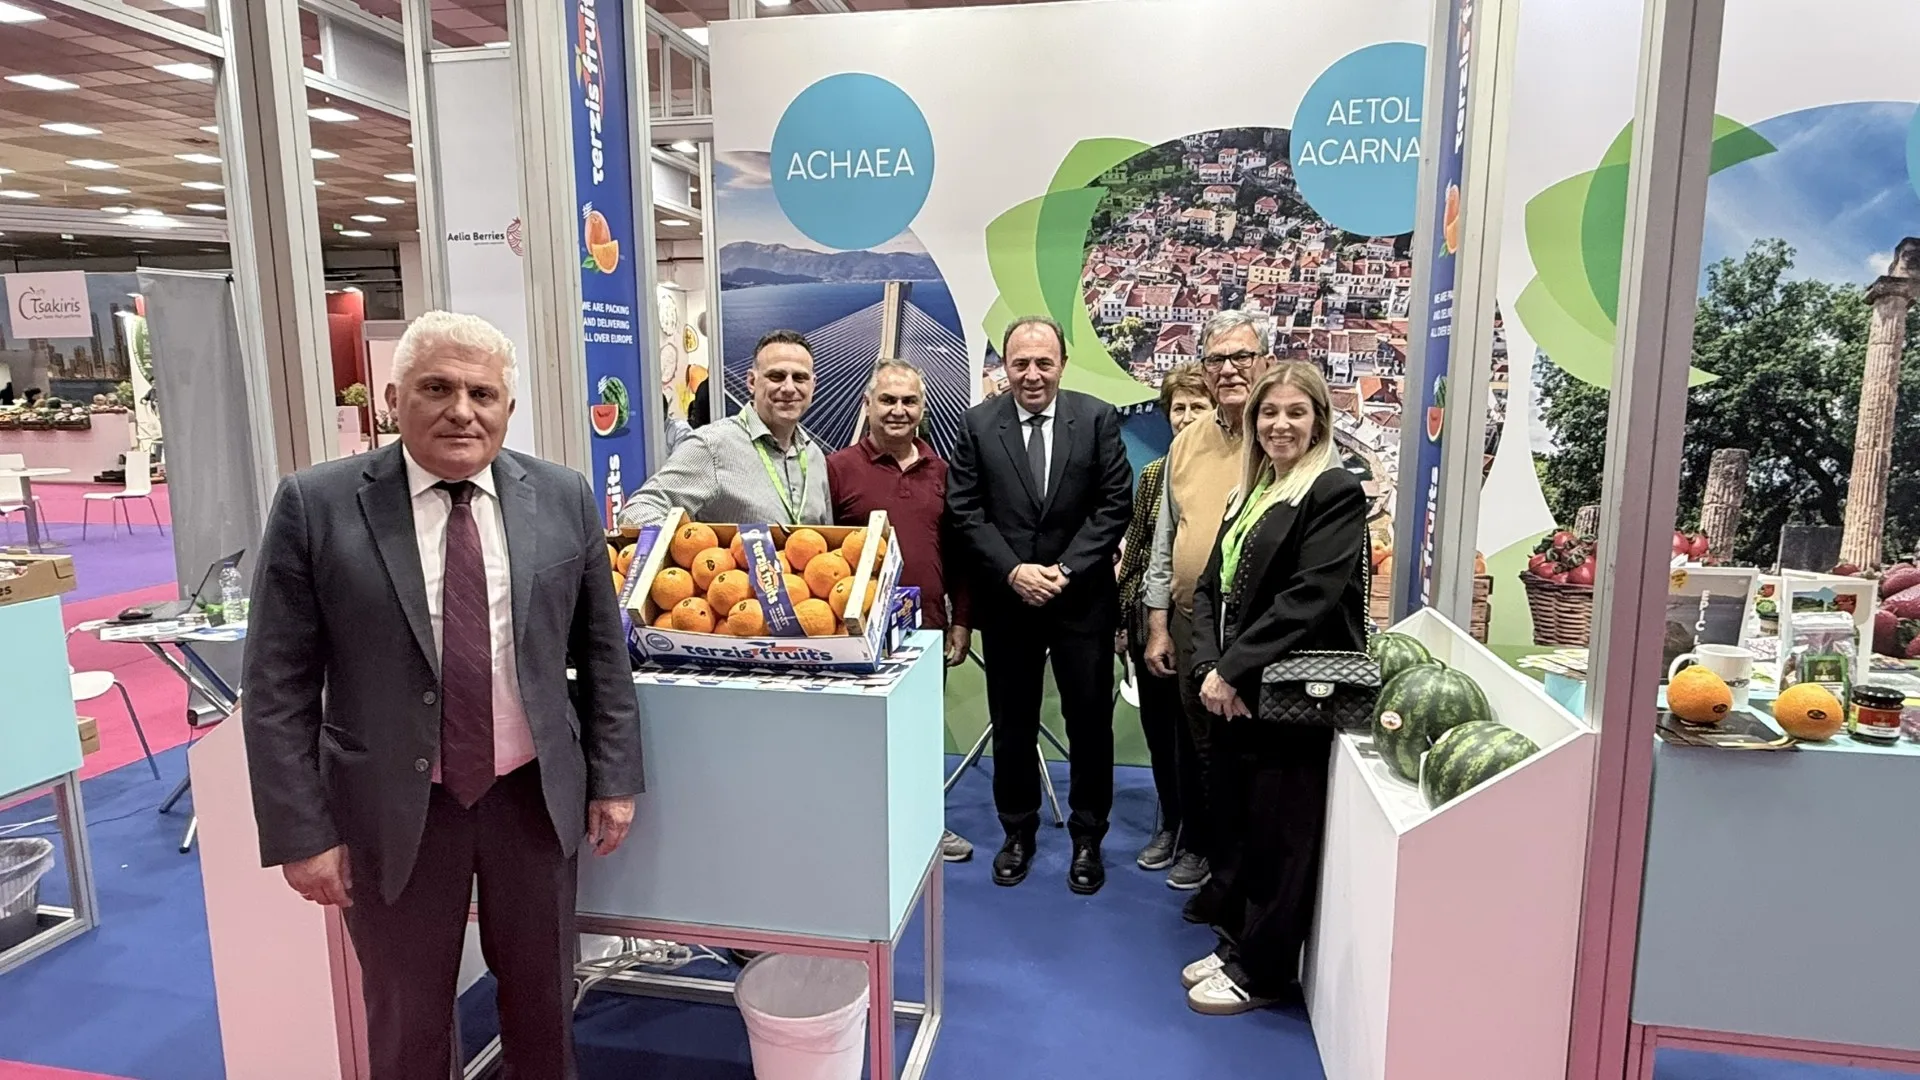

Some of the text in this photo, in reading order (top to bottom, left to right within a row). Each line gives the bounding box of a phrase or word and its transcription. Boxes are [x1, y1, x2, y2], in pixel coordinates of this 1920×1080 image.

[1326, 96, 1420, 126] AETOL
[585, 83, 604, 186] terzis
[1297, 136, 1421, 166] ACARNA
[786, 147, 915, 181] ACHAEA
[447, 230, 505, 242] Aelia Berries
[30, 297, 81, 314] Tsakiris
[592, 302, 604, 313] ARE
[605, 303, 629, 315] PACKING
[597, 318, 630, 330] DELIVERING
[680, 645, 833, 662] terzis fruits
